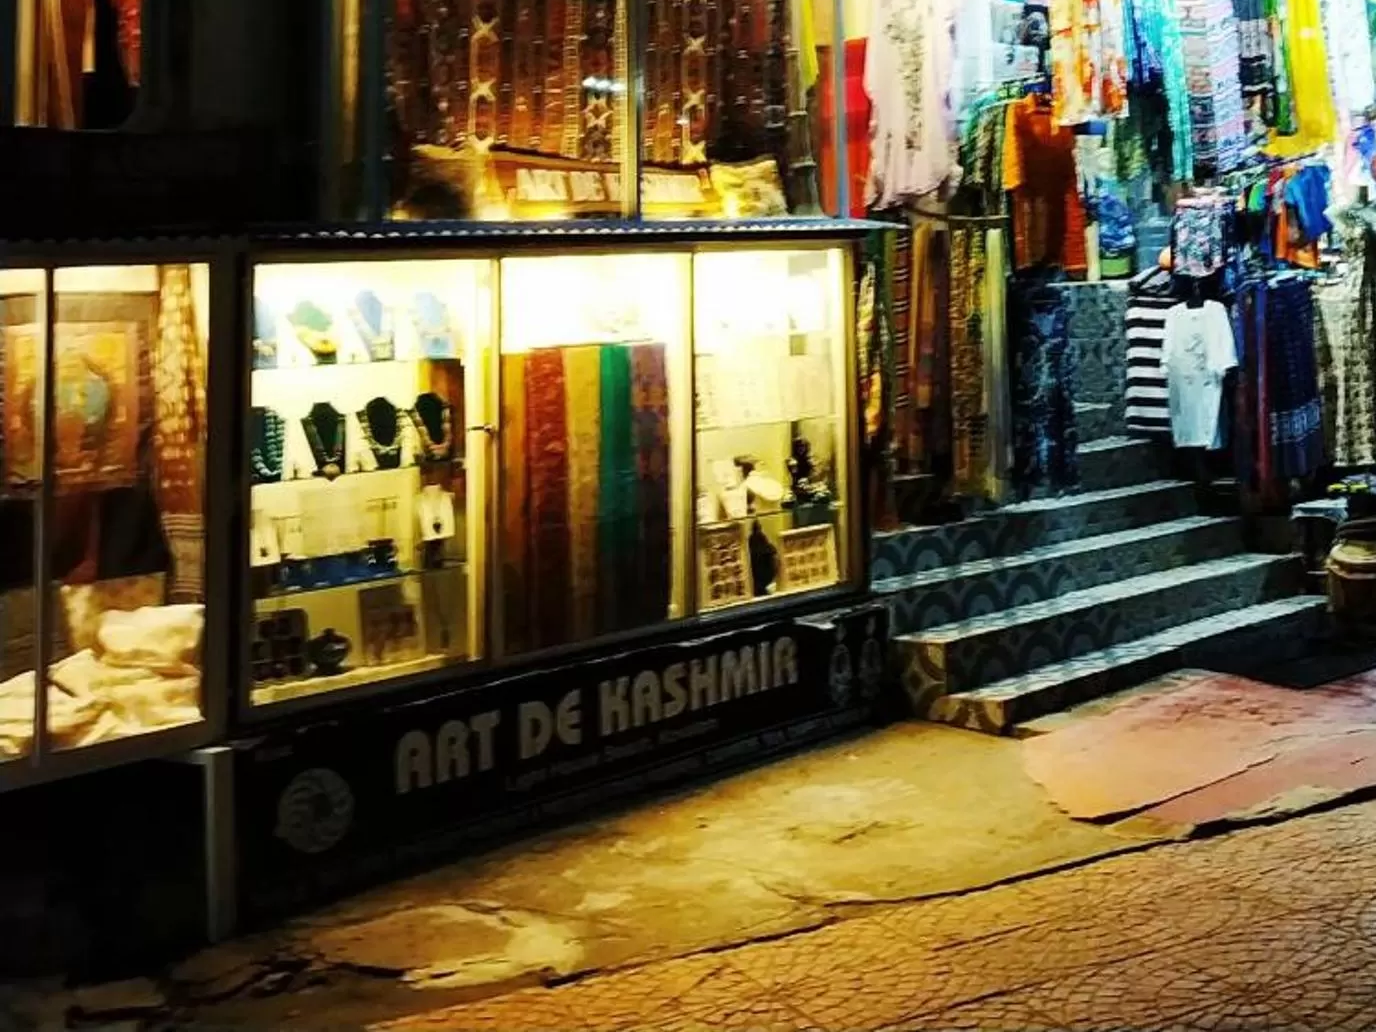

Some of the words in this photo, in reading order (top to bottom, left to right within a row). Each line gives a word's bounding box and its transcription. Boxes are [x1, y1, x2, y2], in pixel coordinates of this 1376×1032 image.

[394, 709, 502, 795] ART
[518, 687, 584, 760] DE
[600, 635, 799, 736] KASHMIR
